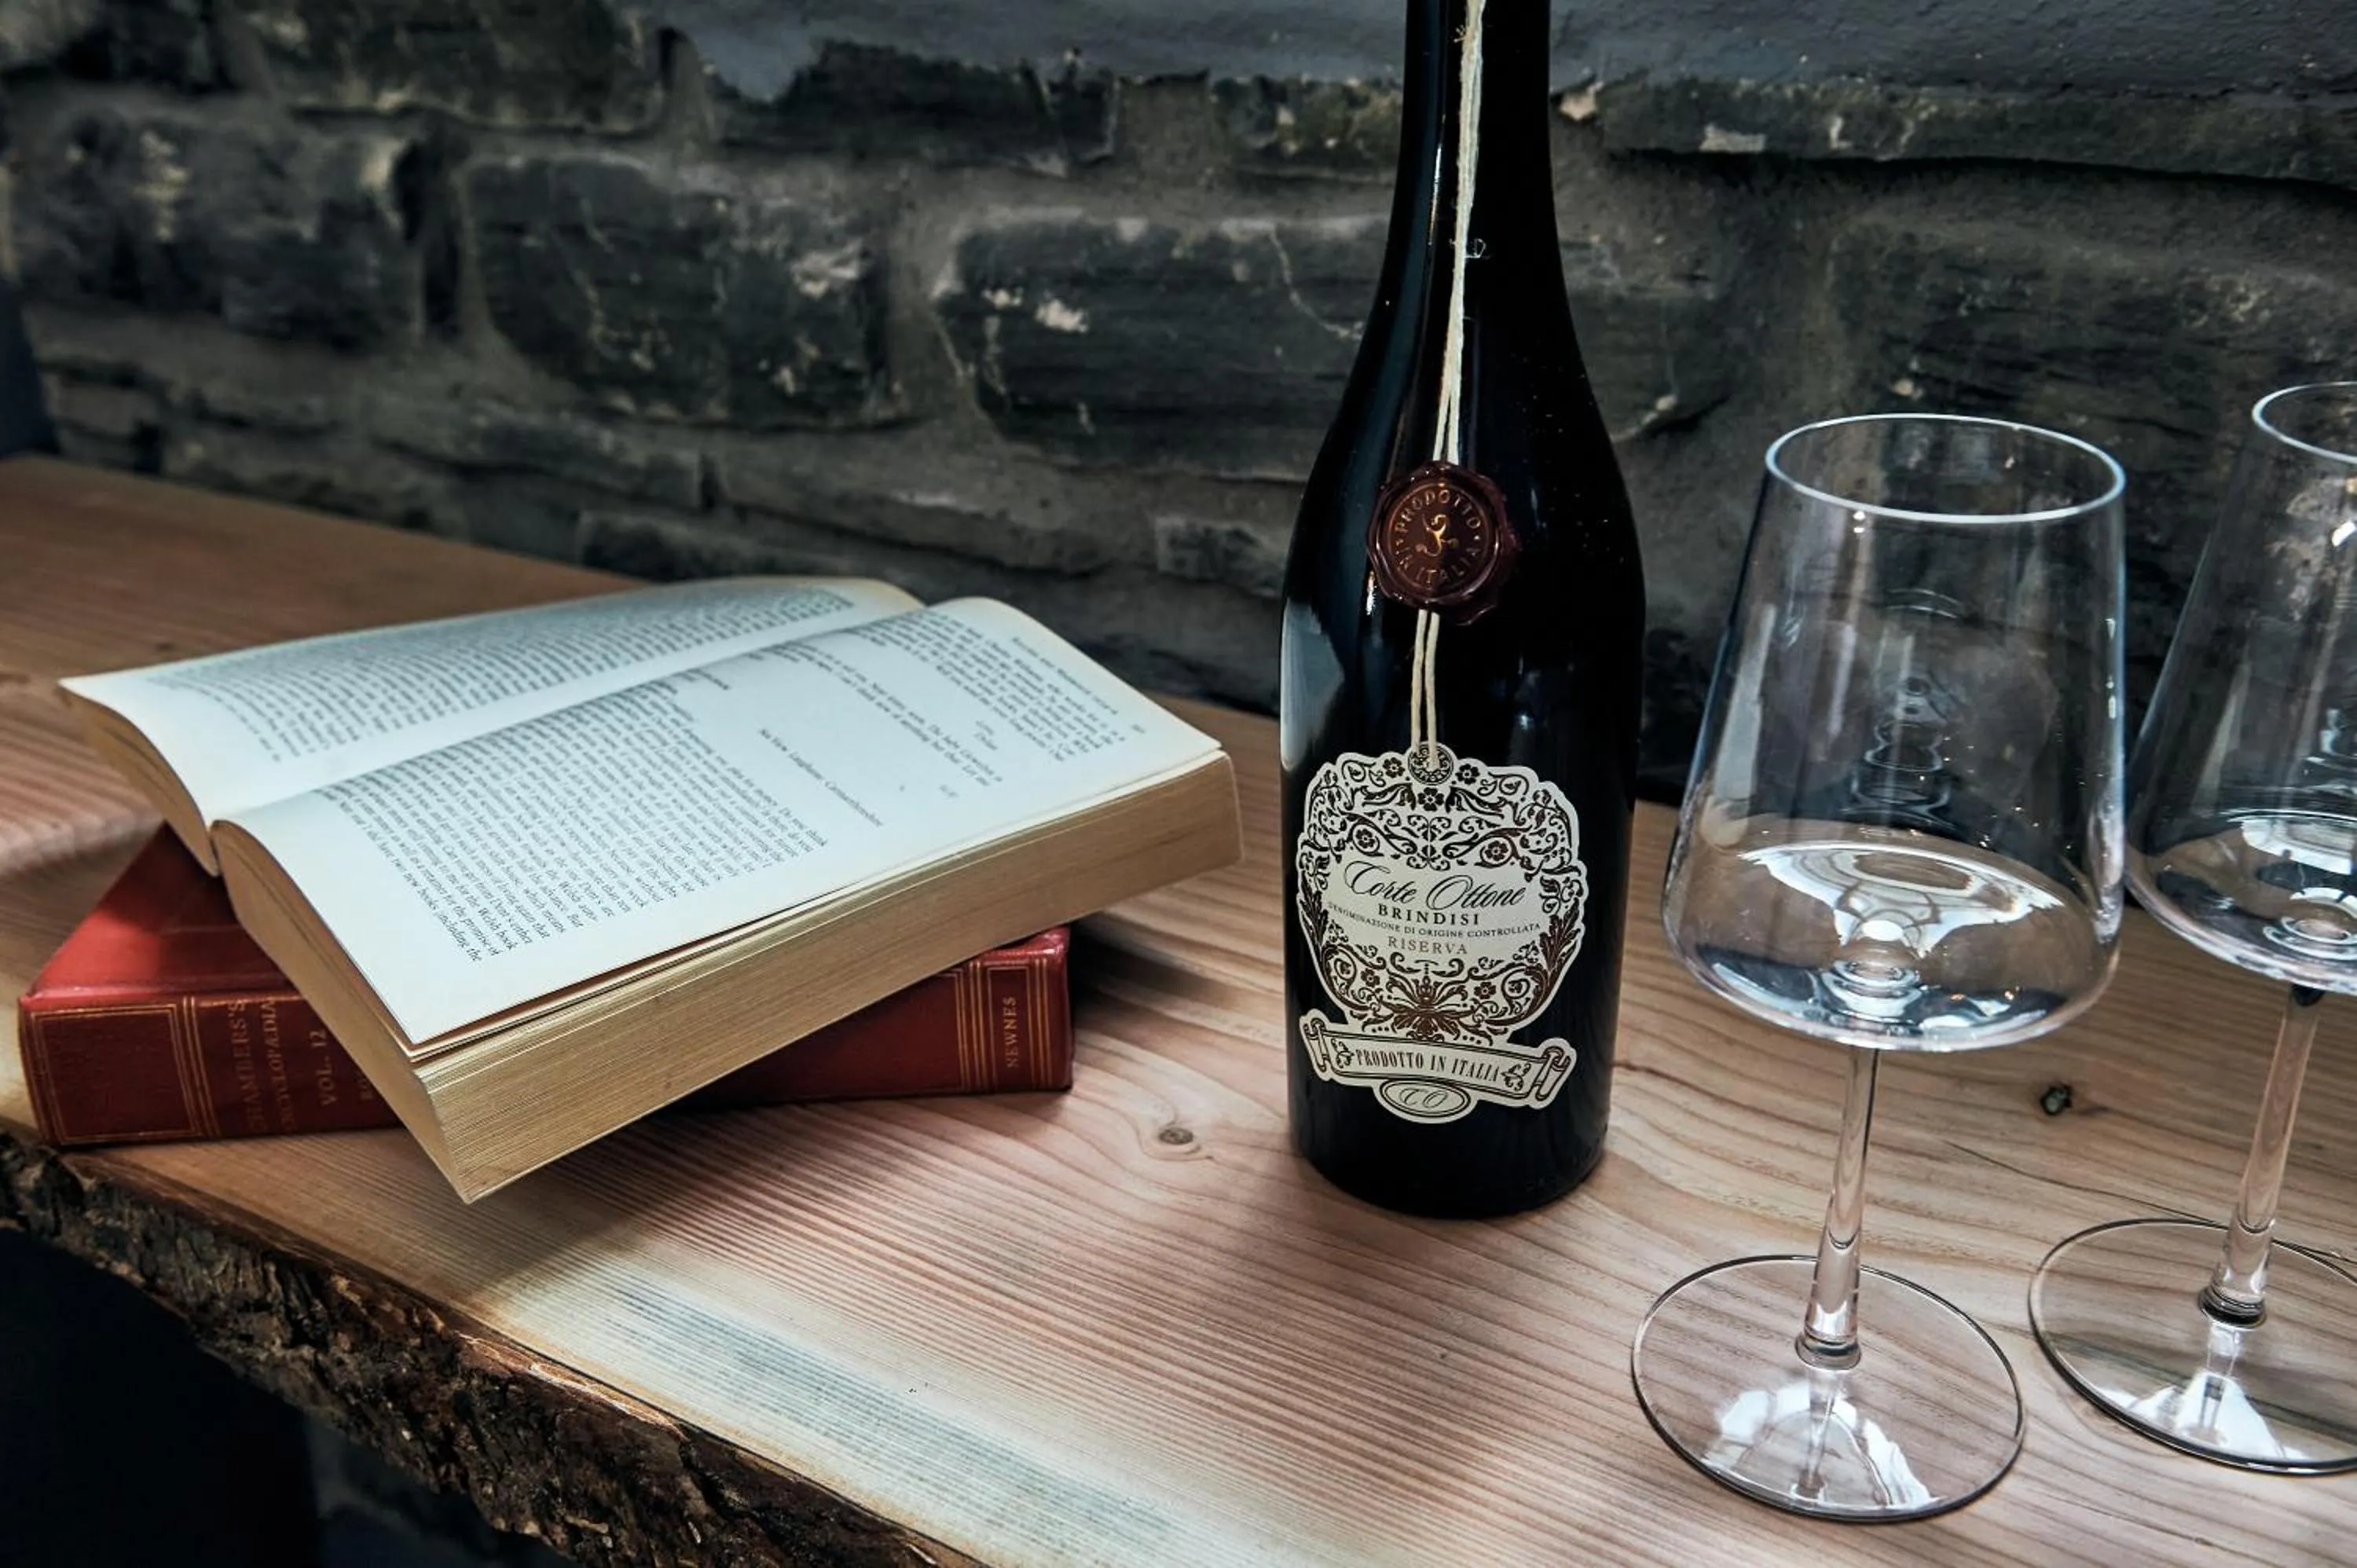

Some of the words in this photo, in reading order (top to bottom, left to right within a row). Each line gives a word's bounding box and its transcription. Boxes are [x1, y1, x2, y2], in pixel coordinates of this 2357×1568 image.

[1344, 860, 1417, 903] Corte
[1426, 874, 1527, 910] Ottone
[1328, 901, 1401, 932] DENOMINAZIONE
[1403, 925, 1415, 935] DI
[1418, 928, 1464, 939] ORIGINE
[1466, 922, 1541, 938] CONTROLLATA
[1377, 903, 1479, 926] BRINDISI
[1387, 936, 1468, 955] RISERVA
[309, 1028, 328, 1049] 12
[1002, 995, 1020, 1069] NEWNES
[315, 1055, 338, 1106] VOL.
[1355, 1049, 1424, 1070] PRODOTTO
[1429, 1054, 1447, 1072] IN
[1452, 1058, 1501, 1082] ITALIA
